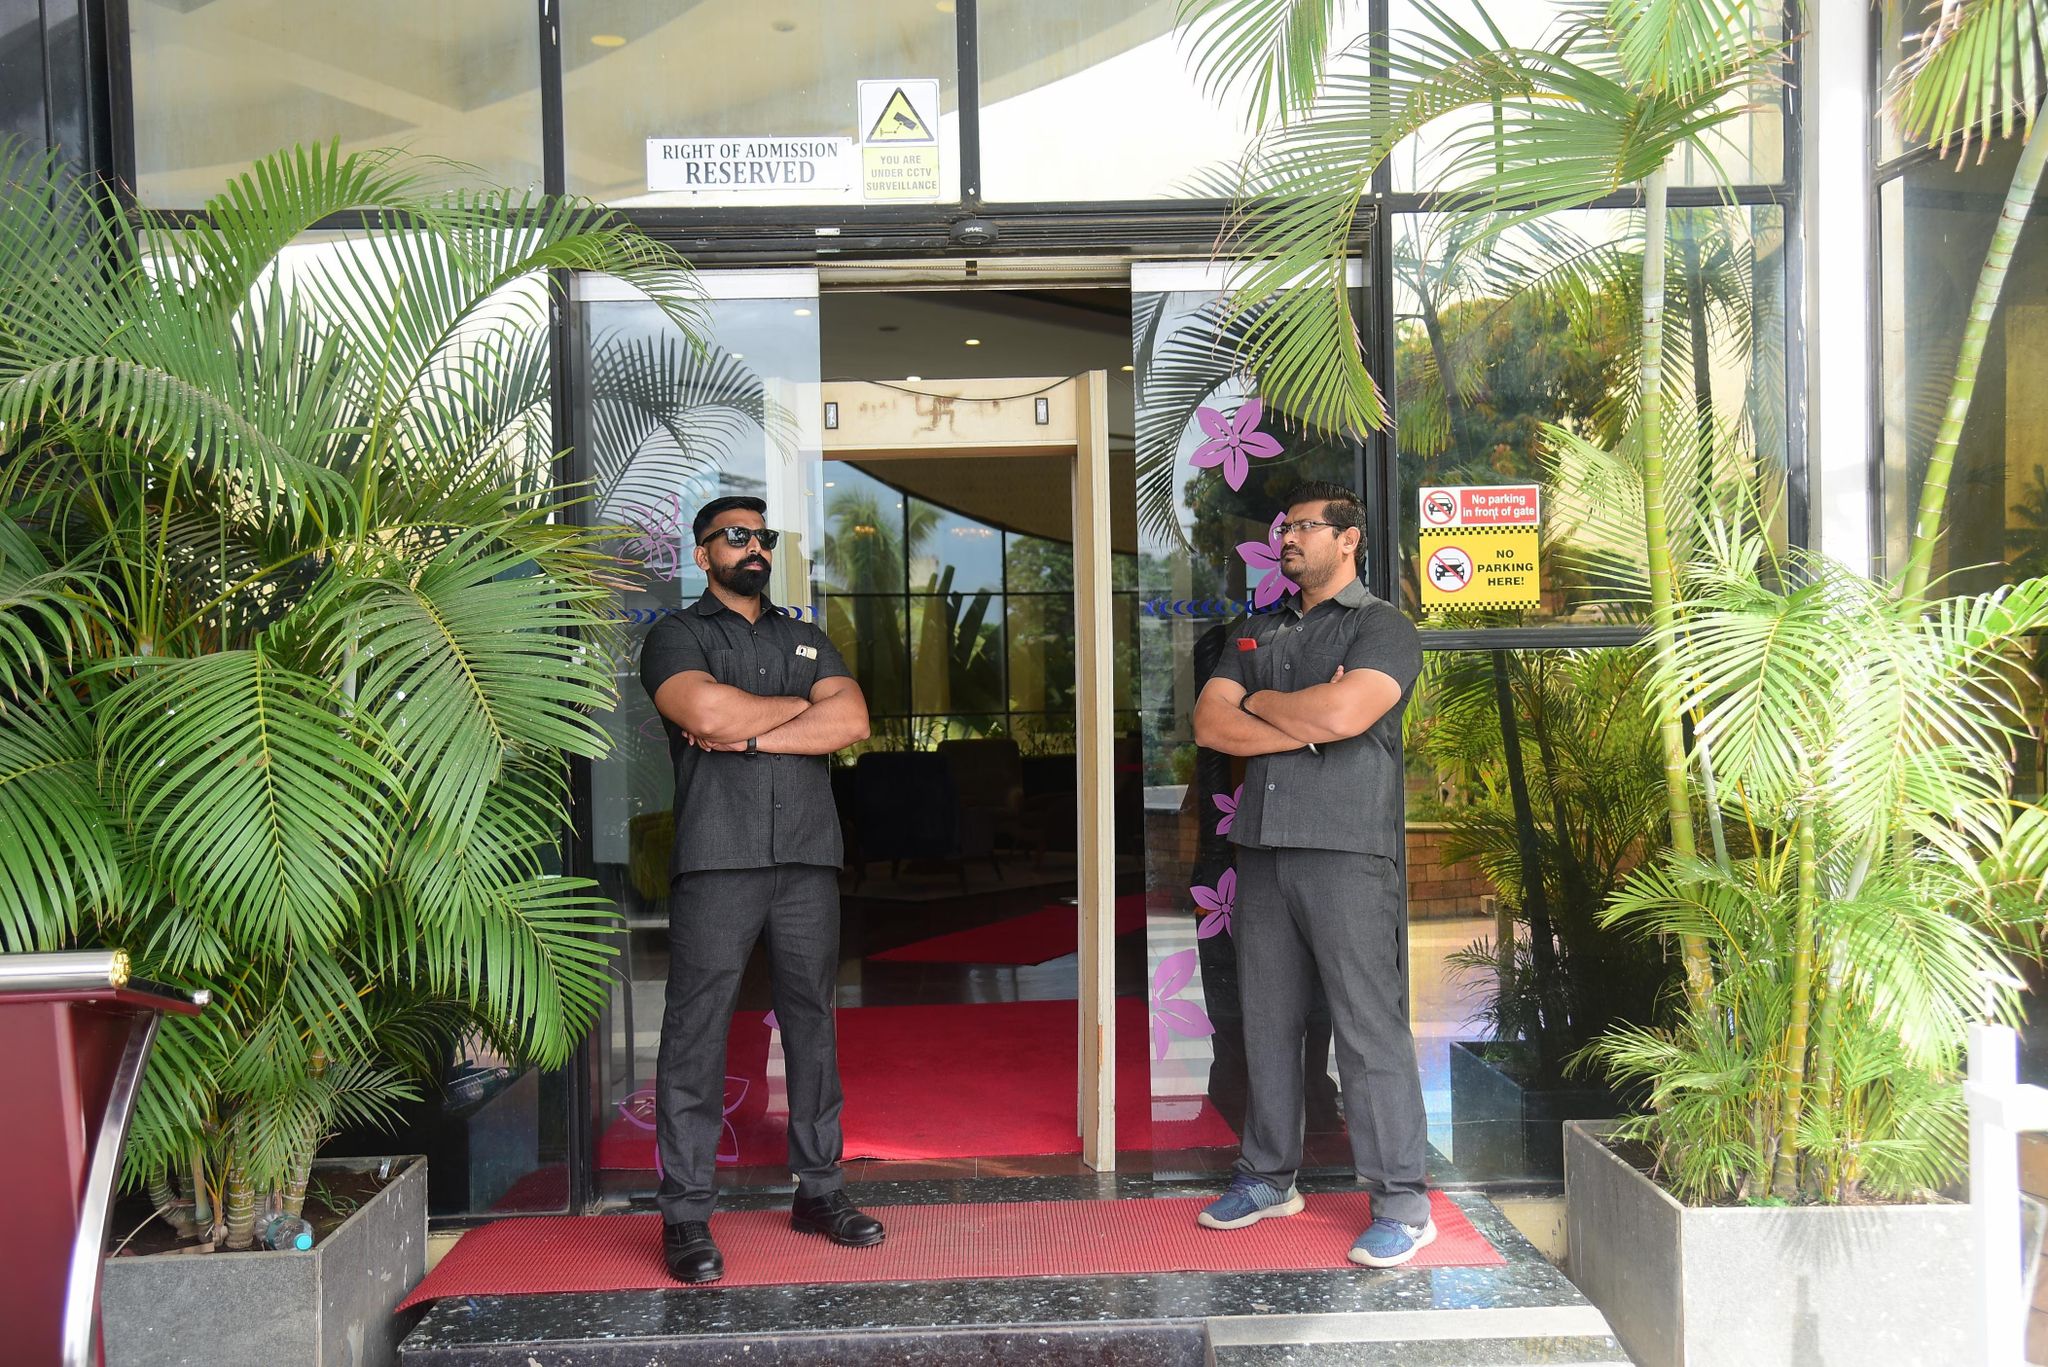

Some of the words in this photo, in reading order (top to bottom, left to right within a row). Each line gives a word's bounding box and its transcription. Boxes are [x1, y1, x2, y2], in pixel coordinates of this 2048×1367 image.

[662, 144, 715, 159] RIGHT
[720, 143, 741, 159] OF
[745, 142, 838, 158] ADMISSION
[880, 155, 900, 165] YOU
[903, 155, 921, 164] ARE
[685, 161, 815, 184] RESERVED
[871, 168, 903, 178] UNDER
[907, 167, 932, 177] CCTV
[866, 180, 937, 191] SURVEILLANCE
[1471, 494, 1486, 504] No
[1488, 494, 1526, 506] parking
[1463, 507, 1472, 517] in
[1475, 506, 1498, 517] front
[1501, 506, 1511, 516] of
[1513, 507, 1535, 518] gate
[1496, 550, 1514, 558] NO
[1477, 563, 1533, 572] PARKING
[1488, 577, 1524, 586] HERE!
